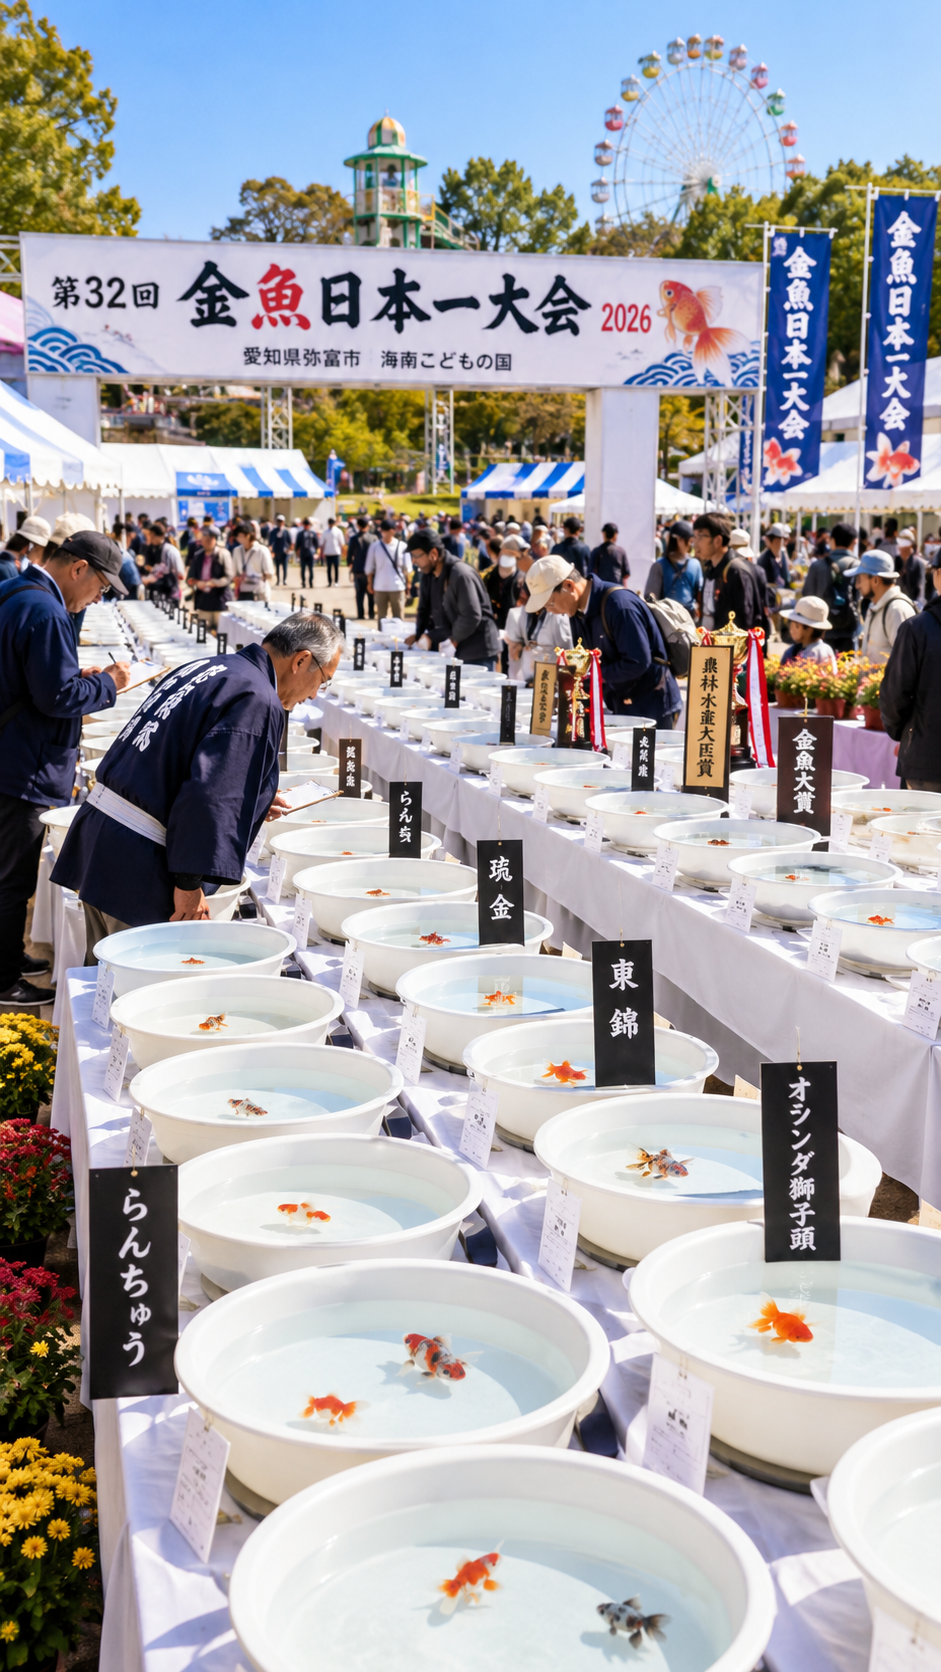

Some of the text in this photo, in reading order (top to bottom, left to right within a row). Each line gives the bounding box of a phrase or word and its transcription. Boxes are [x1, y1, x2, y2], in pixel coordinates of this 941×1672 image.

[51, 260, 652, 336] 第32回 金魚日本一大会 2026
[878, 210, 922, 431] 金魚日本一大会
[243, 346, 512, 372] 愛知県弥富市 海南こどもの国
[778, 245, 818, 441] 金魚日本一大会
[488, 855, 515, 921] 琉金
[608, 958, 640, 1040] 東錦
[117, 1188, 152, 1367] らんちゅう
